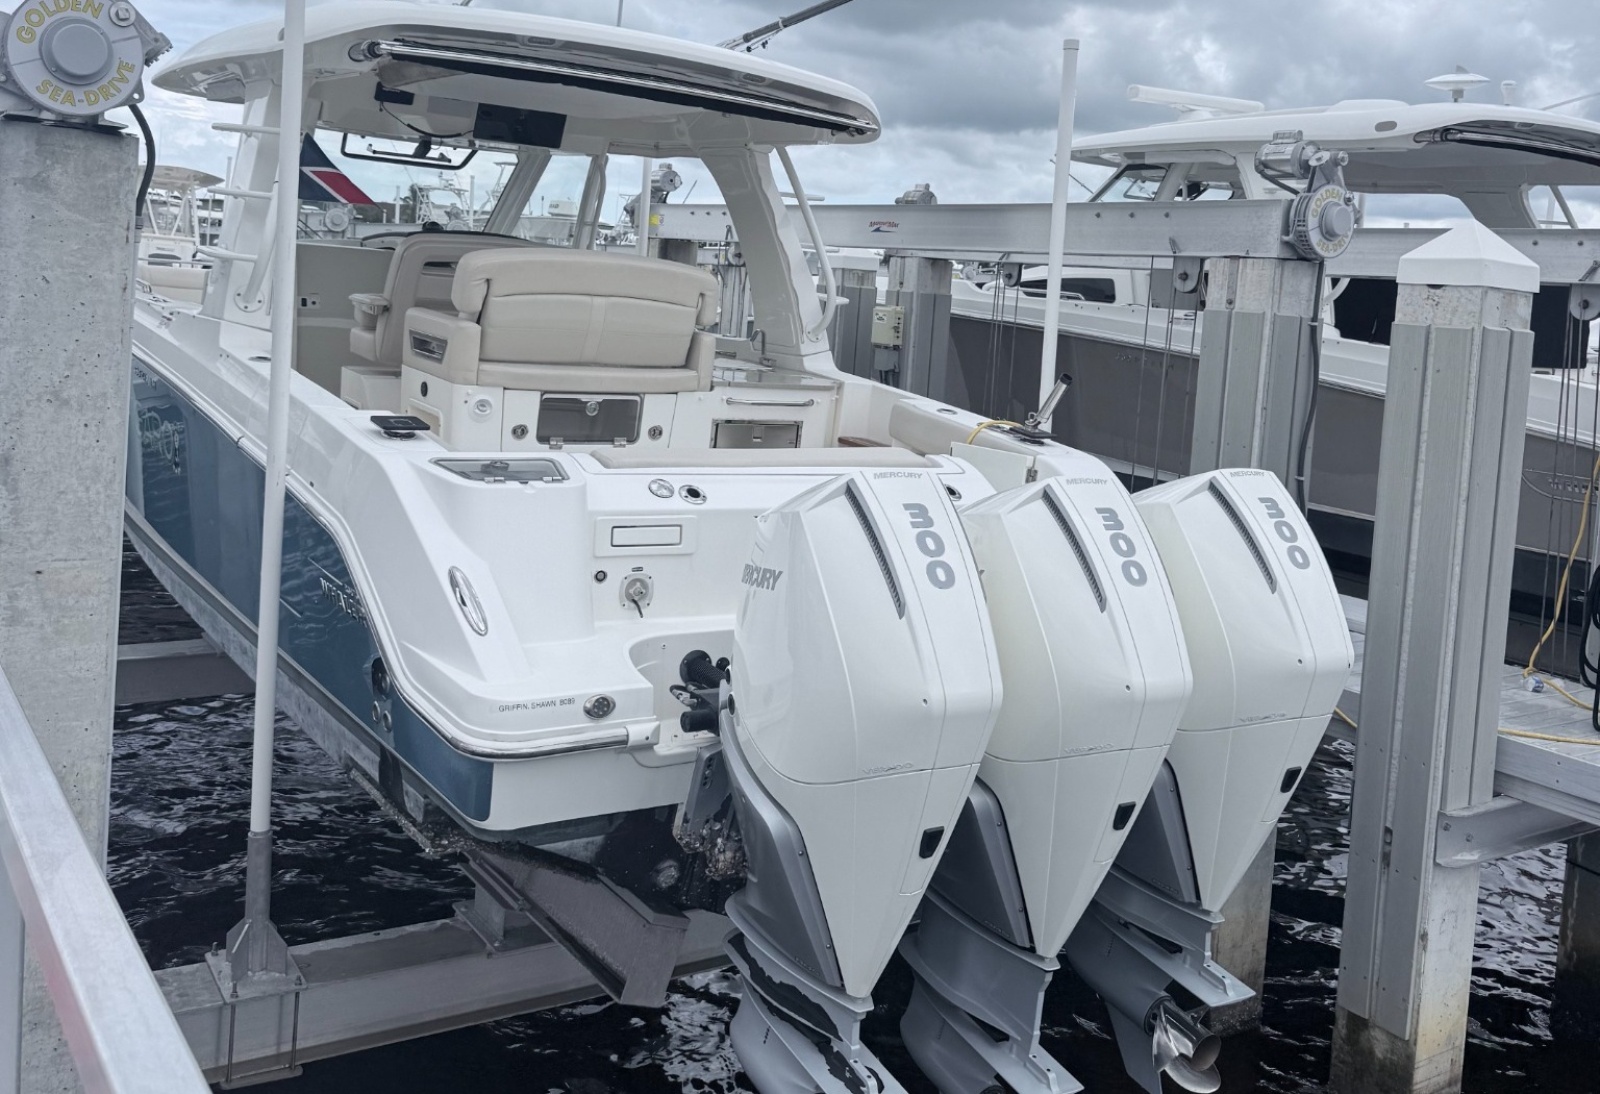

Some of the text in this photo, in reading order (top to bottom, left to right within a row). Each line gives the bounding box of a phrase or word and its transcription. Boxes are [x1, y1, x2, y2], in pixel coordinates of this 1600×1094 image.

[16, 0, 104, 44] GOLDEN
[36, 59, 135, 106] SEA-DRIVE
[1311, 188, 1343, 218] GOLDEN
[873, 471, 923, 480] MERCURY
[1066, 478, 1108, 486] MERCURY
[1230, 470, 1265, 478] MERCURY
[902, 502, 956, 590] 300
[1094, 507, 1148, 588] 300
[1257, 497, 1311, 570] 300
[530, 699, 557, 710] SHAWN
